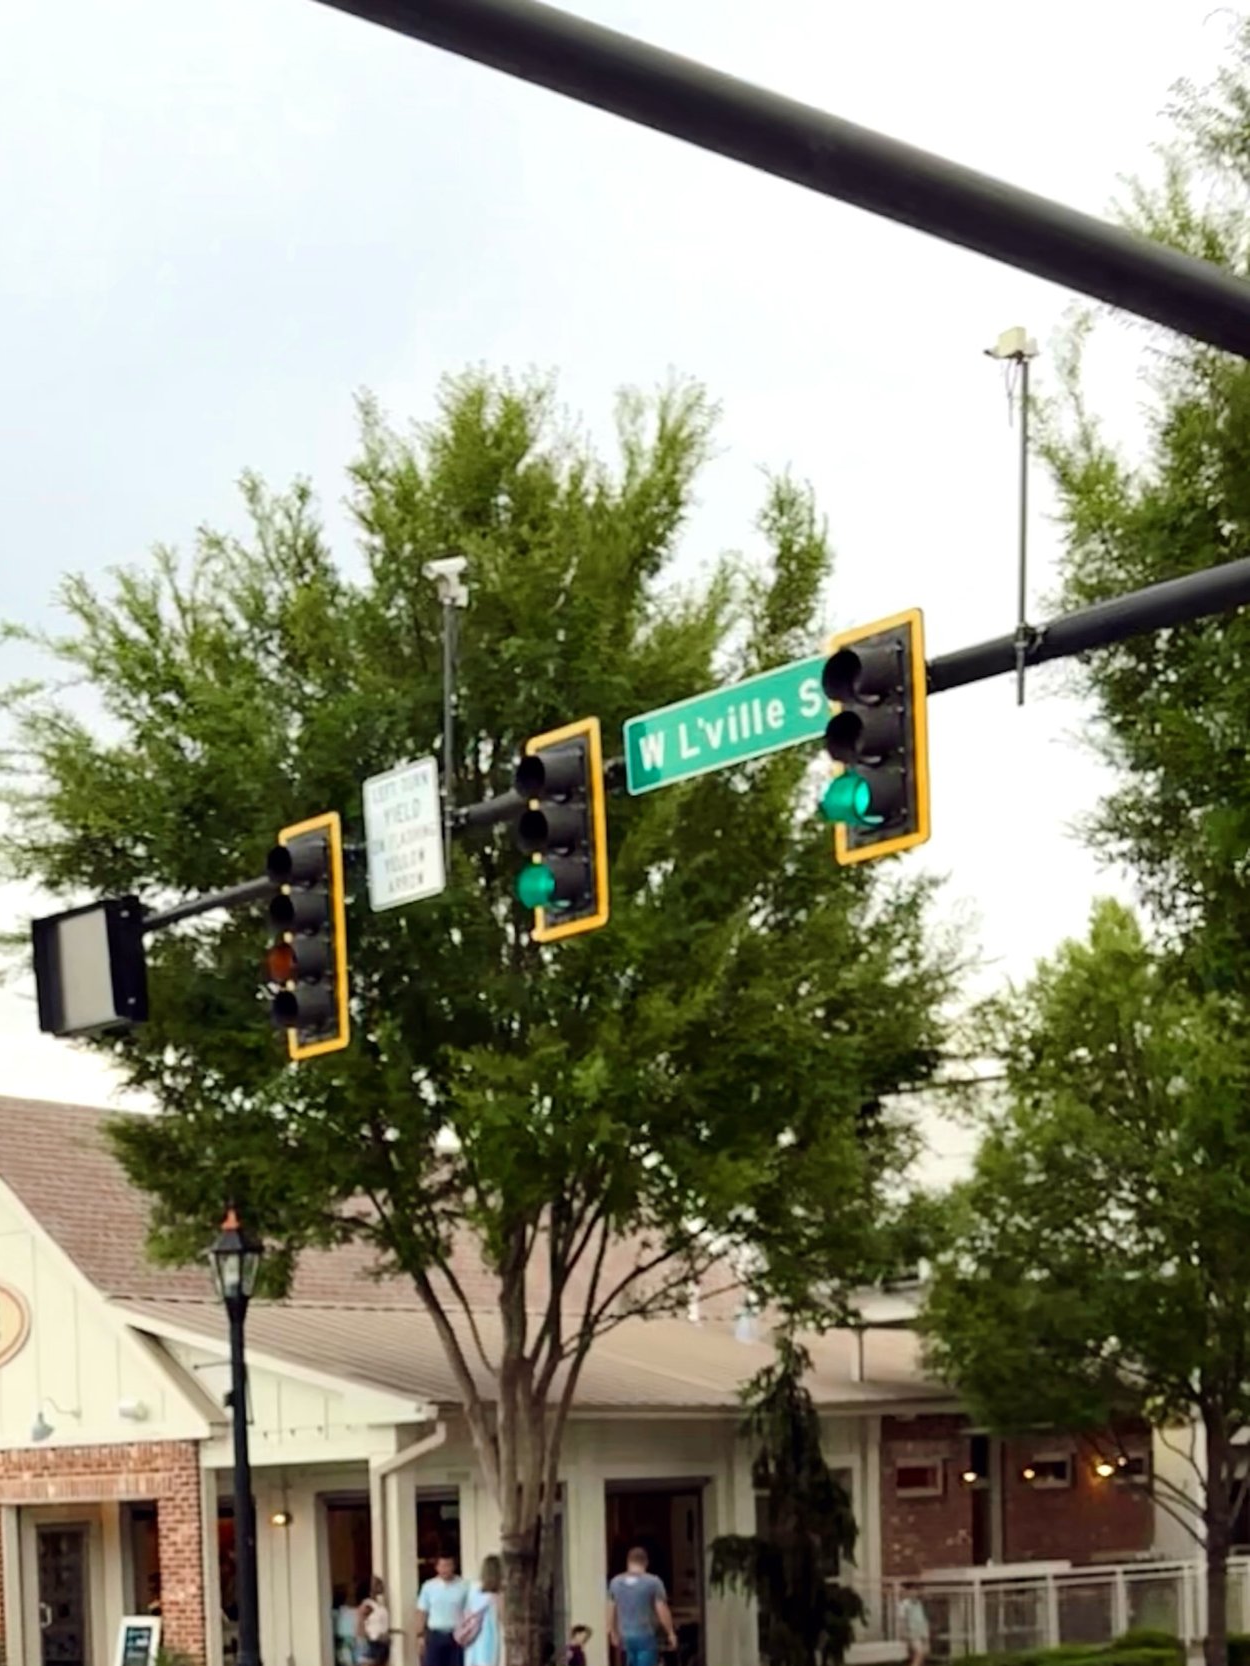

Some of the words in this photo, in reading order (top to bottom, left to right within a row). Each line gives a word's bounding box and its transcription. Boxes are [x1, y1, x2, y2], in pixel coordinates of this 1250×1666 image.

[639, 730, 664, 771] W
[679, 697, 786, 759] L'ville
[799, 678, 823, 718] S
